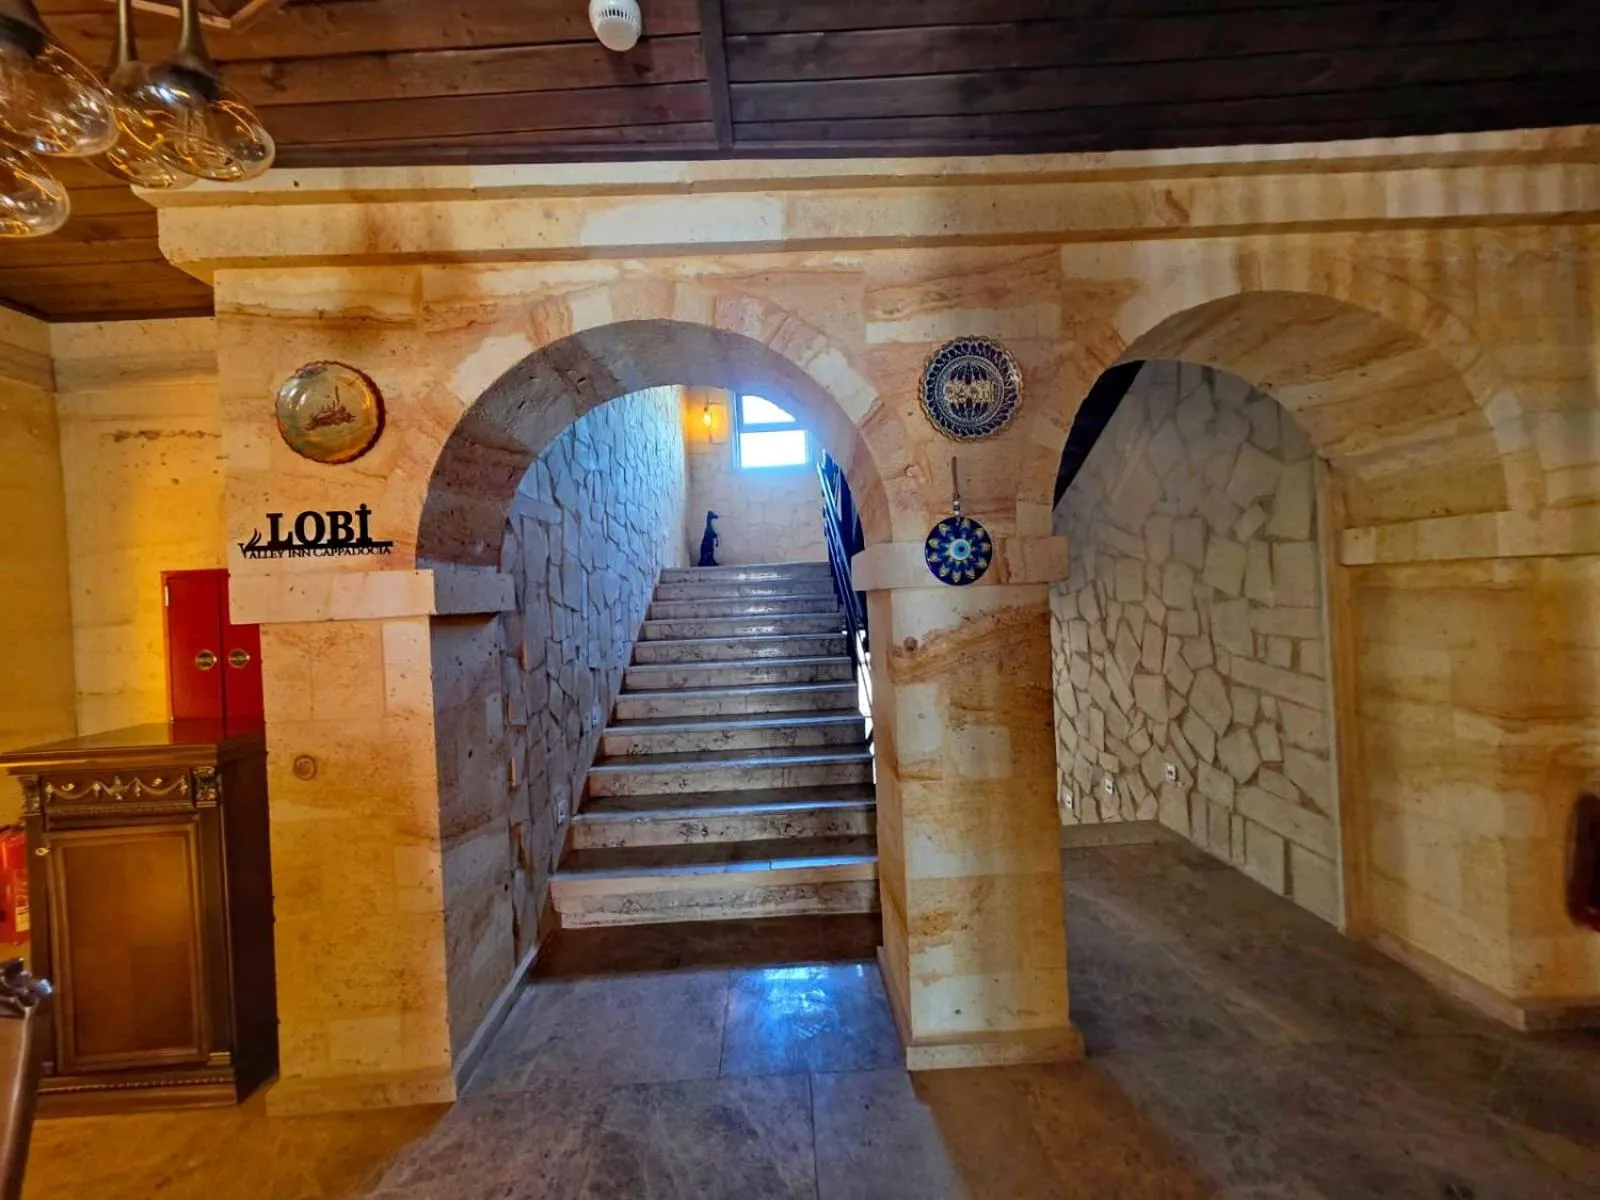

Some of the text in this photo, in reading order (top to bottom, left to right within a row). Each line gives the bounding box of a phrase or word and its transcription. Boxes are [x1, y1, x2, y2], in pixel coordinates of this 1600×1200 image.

[266, 503, 372, 545] LOBİ
[238, 543, 392, 559] VALLEY INN CAPPADOCIA
